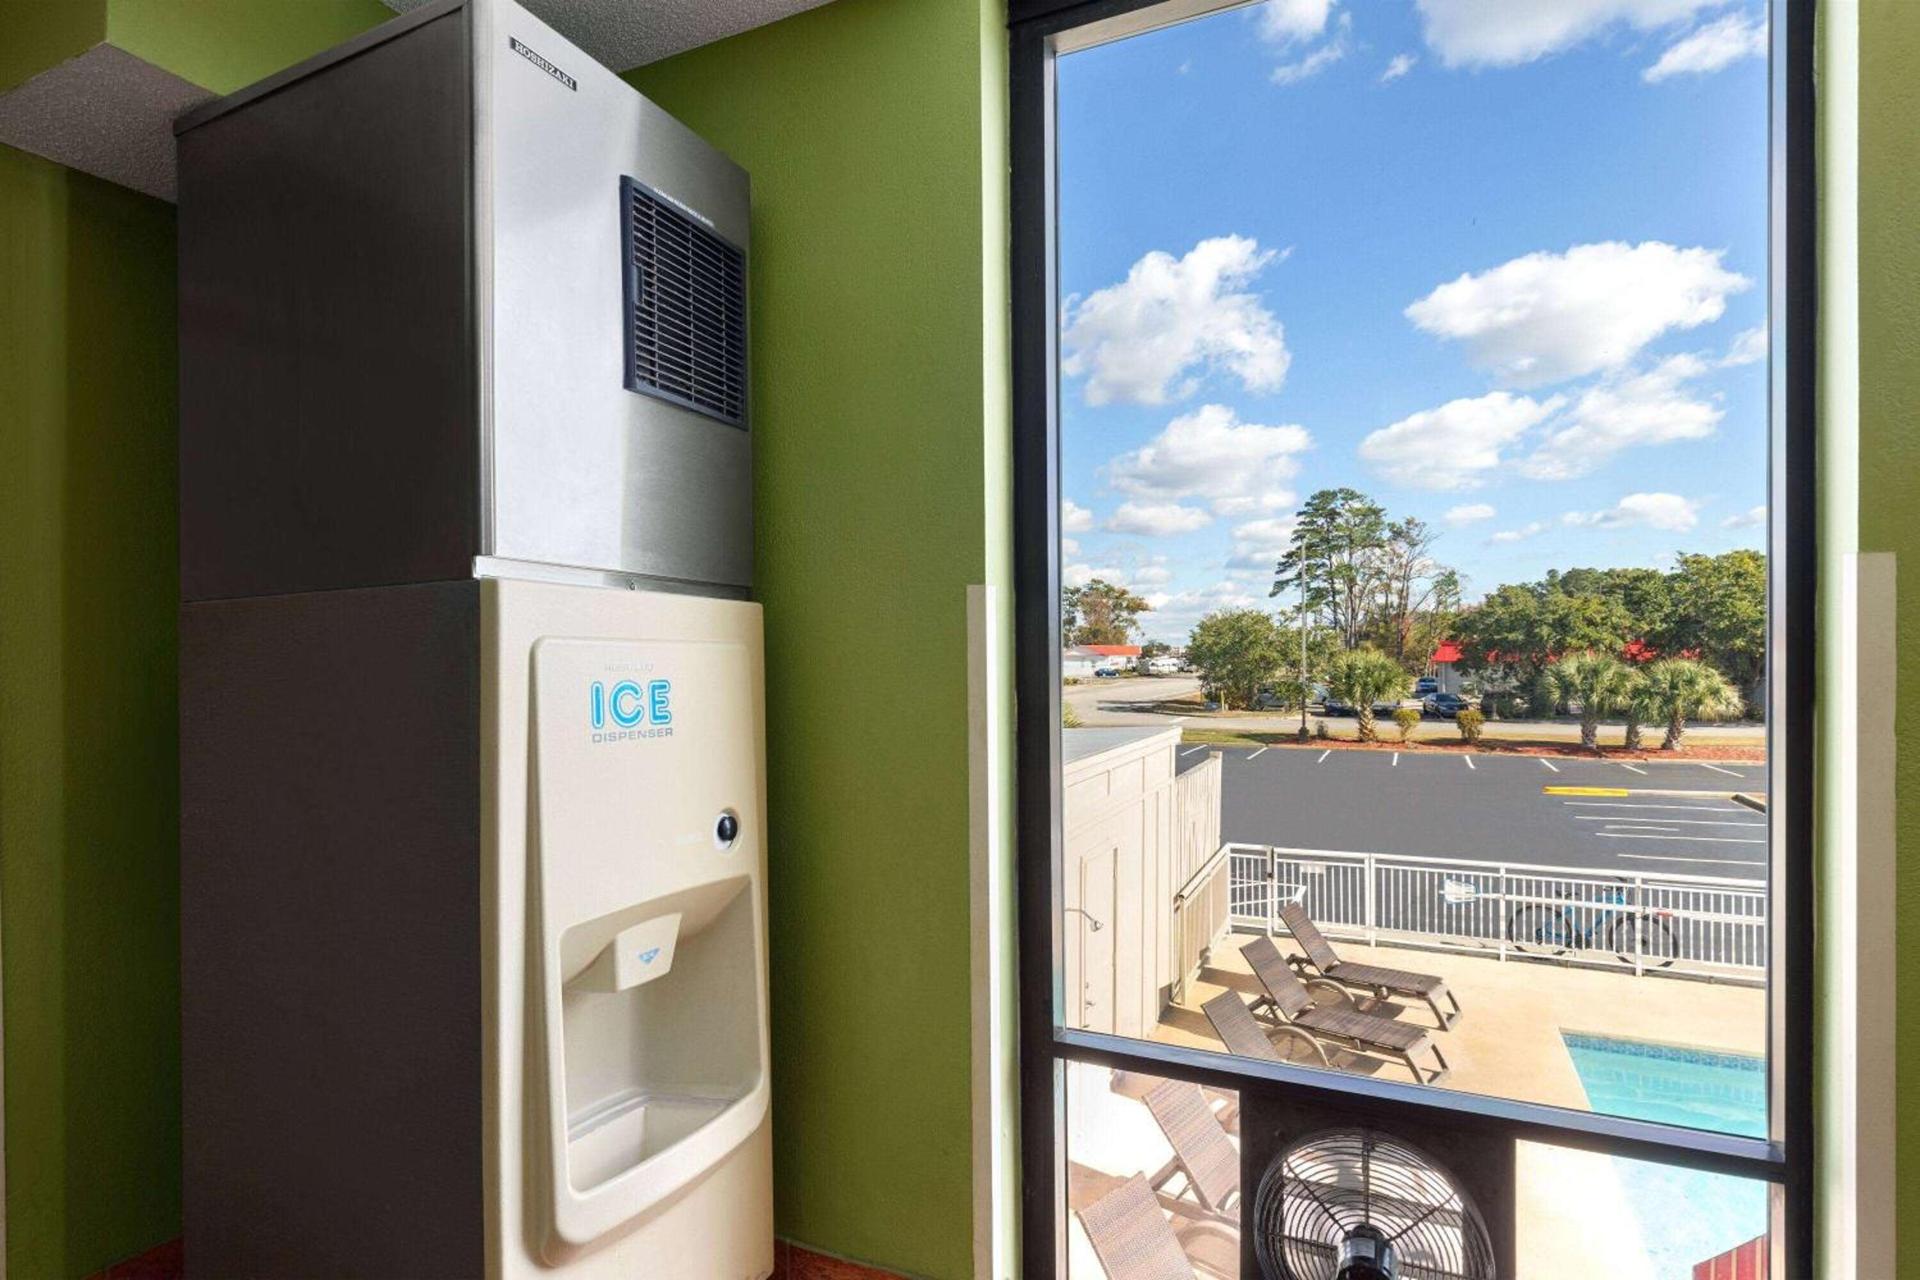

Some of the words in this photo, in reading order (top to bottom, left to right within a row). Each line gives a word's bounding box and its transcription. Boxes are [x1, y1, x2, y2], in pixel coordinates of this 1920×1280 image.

[514, 41, 573, 88] HOSHIZAKI
[591, 680, 672, 729] ICE
[592, 727, 673, 743] DISPENSER
